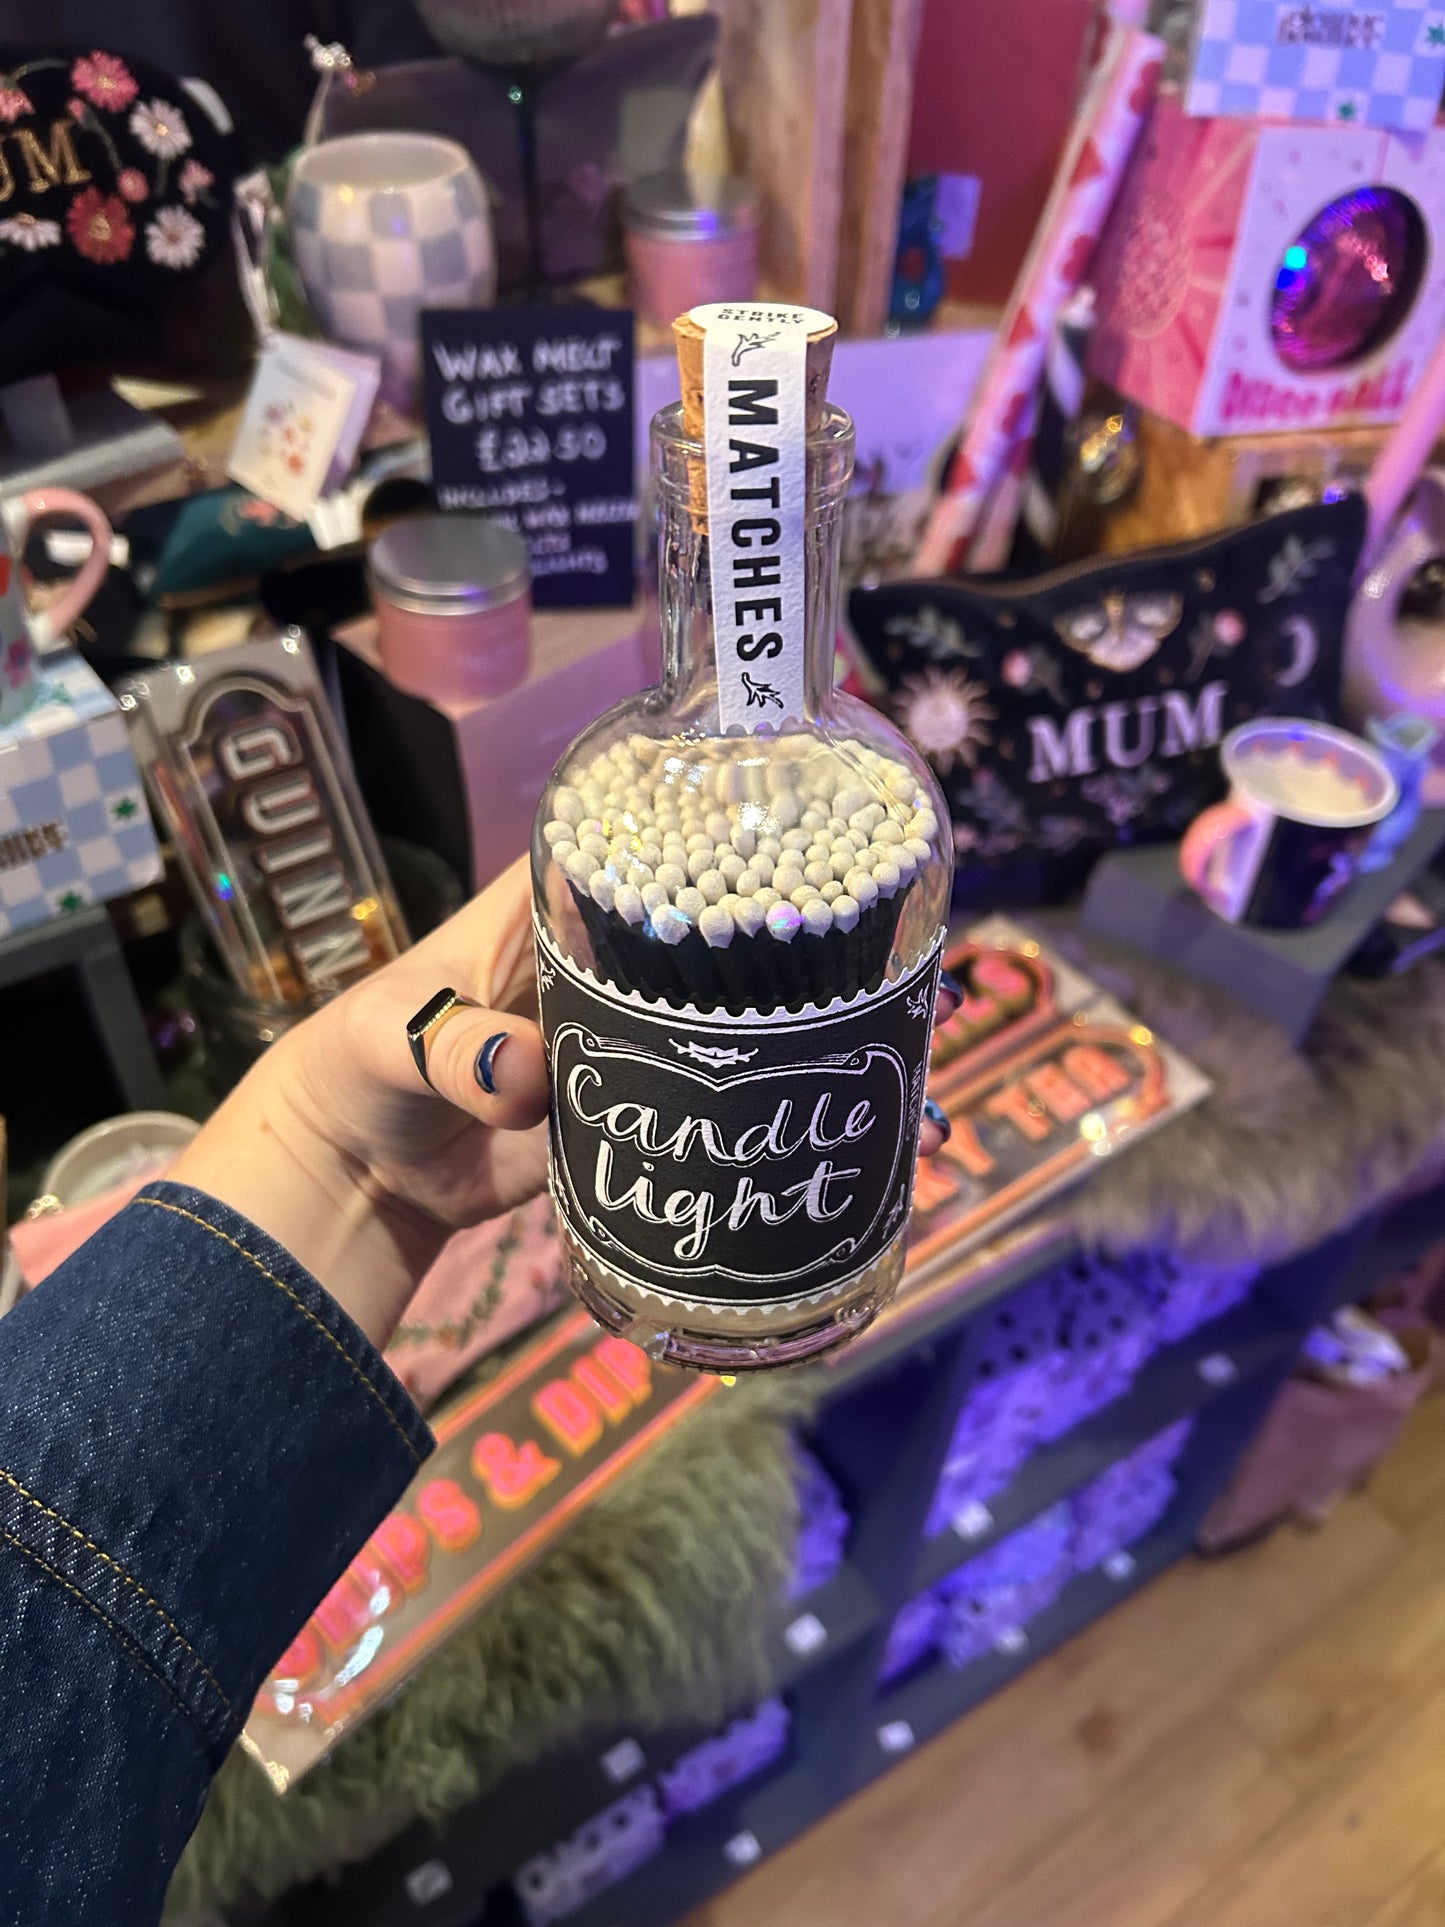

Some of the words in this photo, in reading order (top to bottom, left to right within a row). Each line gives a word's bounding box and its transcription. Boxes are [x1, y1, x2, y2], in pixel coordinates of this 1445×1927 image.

[432, 341, 523, 382] WAX
[532, 334, 622, 373] MELT
[717, 314, 804, 324] GENTLY
[721, 308, 804, 319] STRIKE
[441, 383, 533, 424] GIFT
[536, 375, 626, 416] SETS
[728, 379, 784, 662] MATCHES
[1027, 680, 1231, 783] MUM
[567, 1063, 876, 1168] Candle
[595, 1140, 861, 1261] light
[472, 1431, 562, 1508] &
[532, 1335, 660, 1457] DIP
